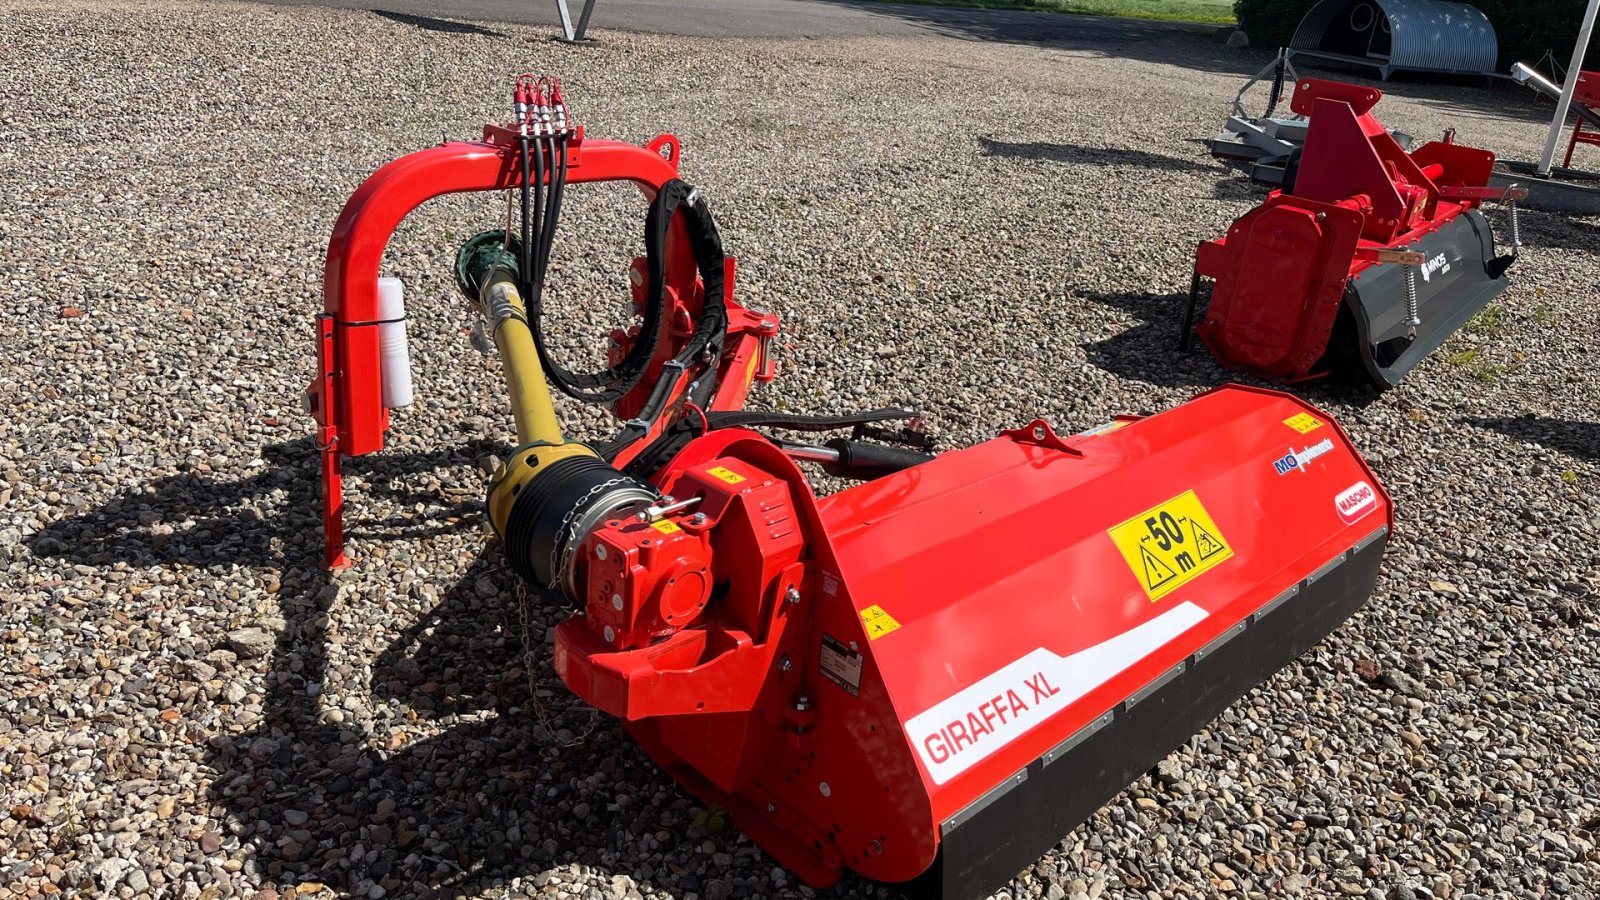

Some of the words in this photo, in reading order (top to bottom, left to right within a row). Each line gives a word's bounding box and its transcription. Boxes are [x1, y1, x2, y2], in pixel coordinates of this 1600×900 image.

[1273, 455, 1298, 474] MO
[1339, 486, 1372, 512] MASCHIO
[1144, 511, 1184, 551] 50
[1174, 551, 1196, 573] m
[924, 689, 1029, 764] GIRAFFA
[1023, 672, 1061, 705] XL
